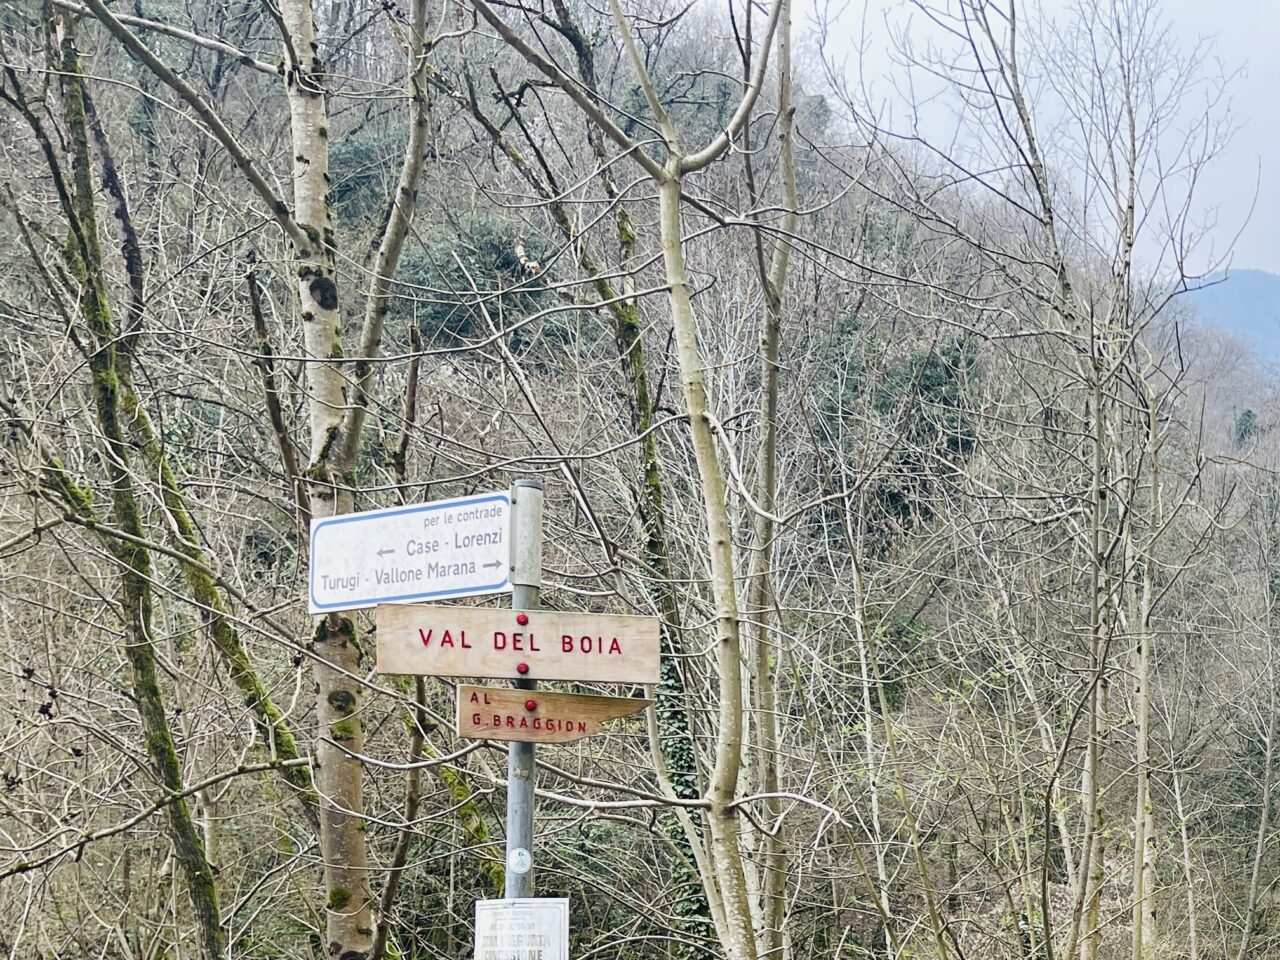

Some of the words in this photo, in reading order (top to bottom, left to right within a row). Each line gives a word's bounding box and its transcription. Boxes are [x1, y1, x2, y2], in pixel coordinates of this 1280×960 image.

[424, 515, 440, 529] per
[444, 511, 453, 524] le
[457, 505, 502, 523] contrade
[406, 539, 439, 557] Case
[454, 527, 503, 549] Lorenzi
[321, 572, 360, 591] Turugi
[375, 566, 423, 586] Vallone
[427, 560, 476, 579] Marana
[418, 628, 472, 649] VAL
[494, 632, 541, 652] DEL
[562, 635, 622, 656] BOIA
[470, 692, 491, 705] AL
